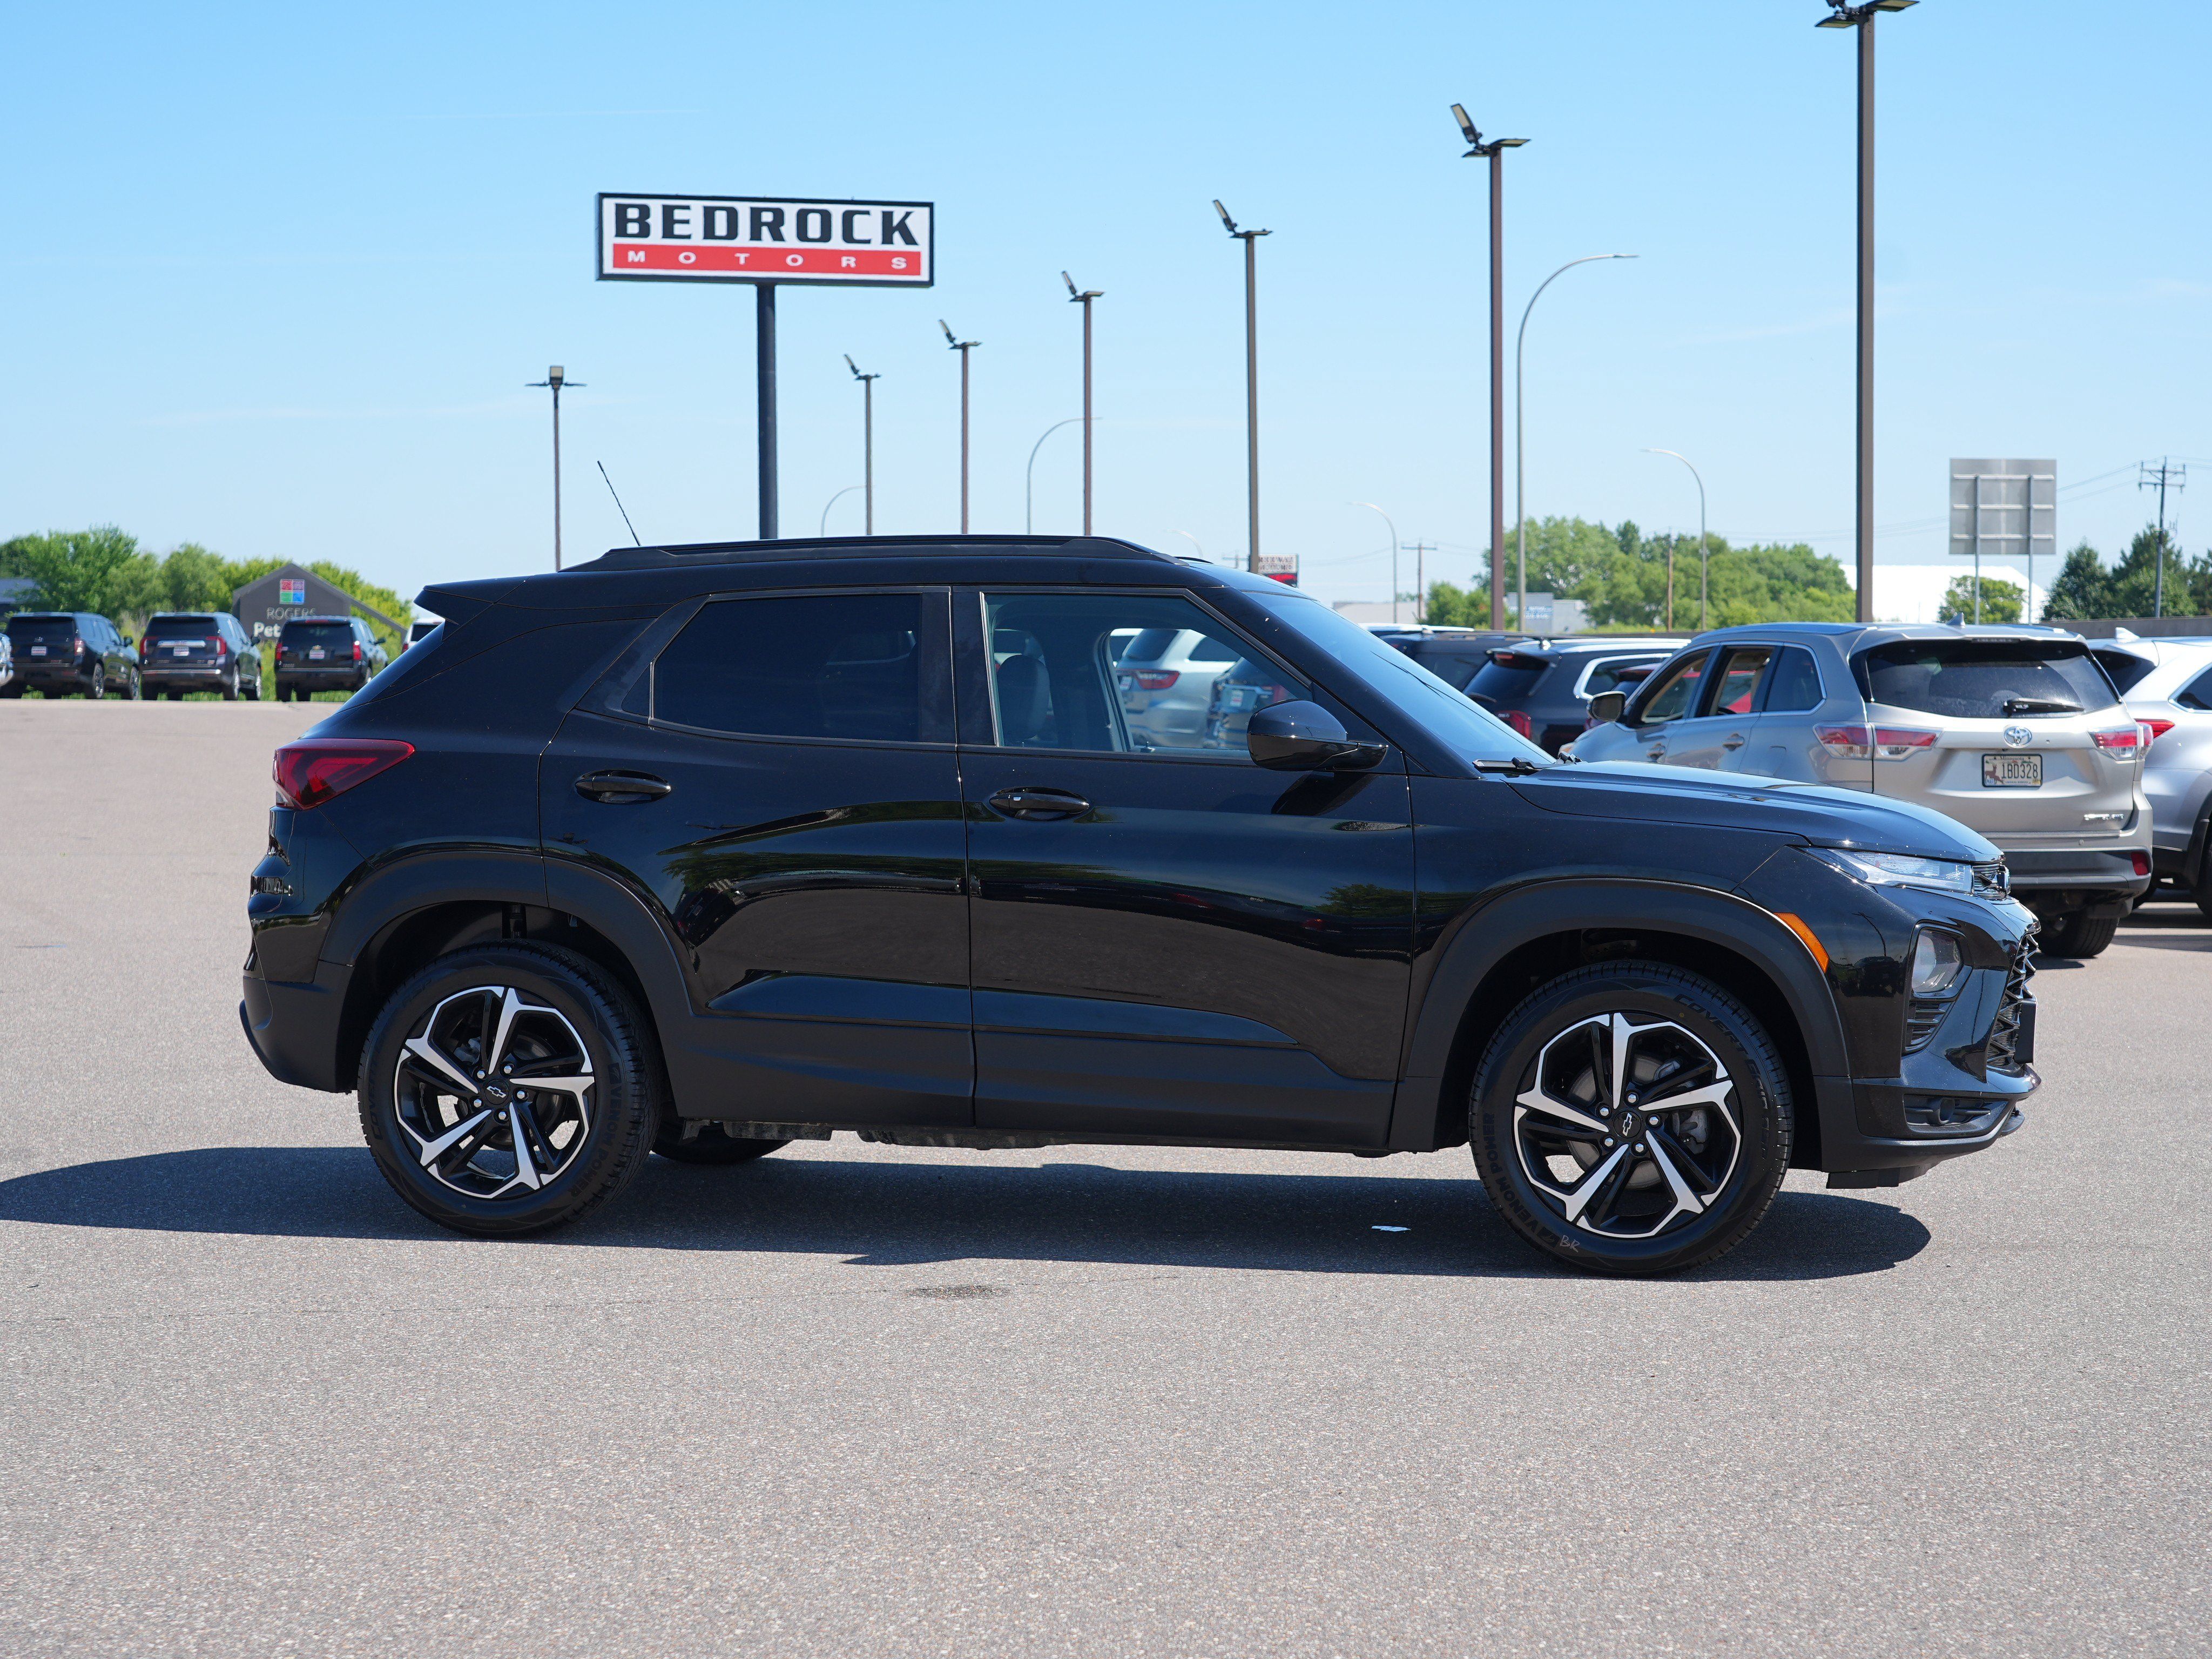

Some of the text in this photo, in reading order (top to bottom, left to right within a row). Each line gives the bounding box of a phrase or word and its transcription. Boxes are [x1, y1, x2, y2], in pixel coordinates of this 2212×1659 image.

[613, 203, 919, 246] BEDROCK
[627, 250, 908, 270] MOTORS
[253, 622, 281, 638] Pet
[2001, 763, 2038, 779] 1BD328
[1482, 1112, 1540, 1232] VENOM POWER
[1560, 1235, 1580, 1253] BR
